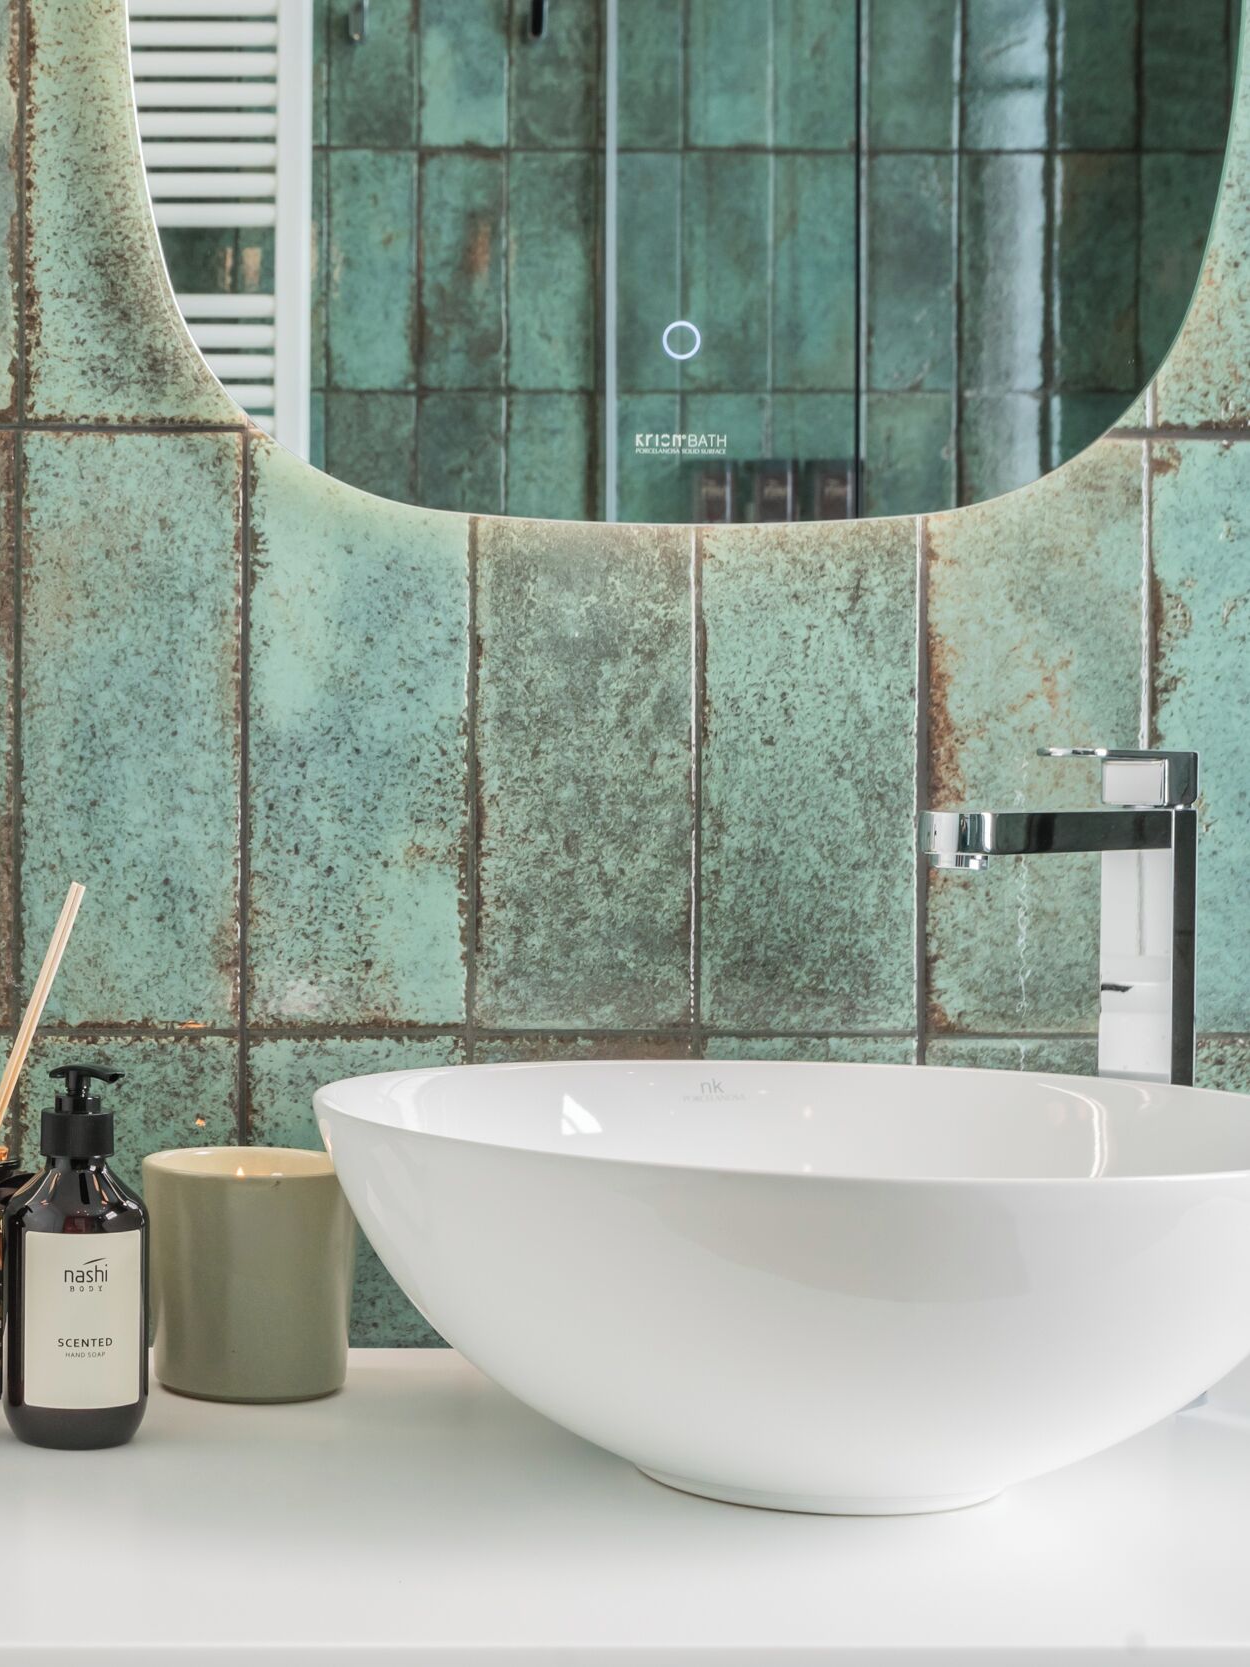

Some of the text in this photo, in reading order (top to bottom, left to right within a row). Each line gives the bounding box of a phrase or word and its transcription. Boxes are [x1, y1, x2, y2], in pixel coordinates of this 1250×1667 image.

[687, 433, 727, 447] BATH
[700, 1078, 725, 1094] nk
[64, 1263, 108, 1283] nashi
[57, 1337, 113, 1347] SCENTED
